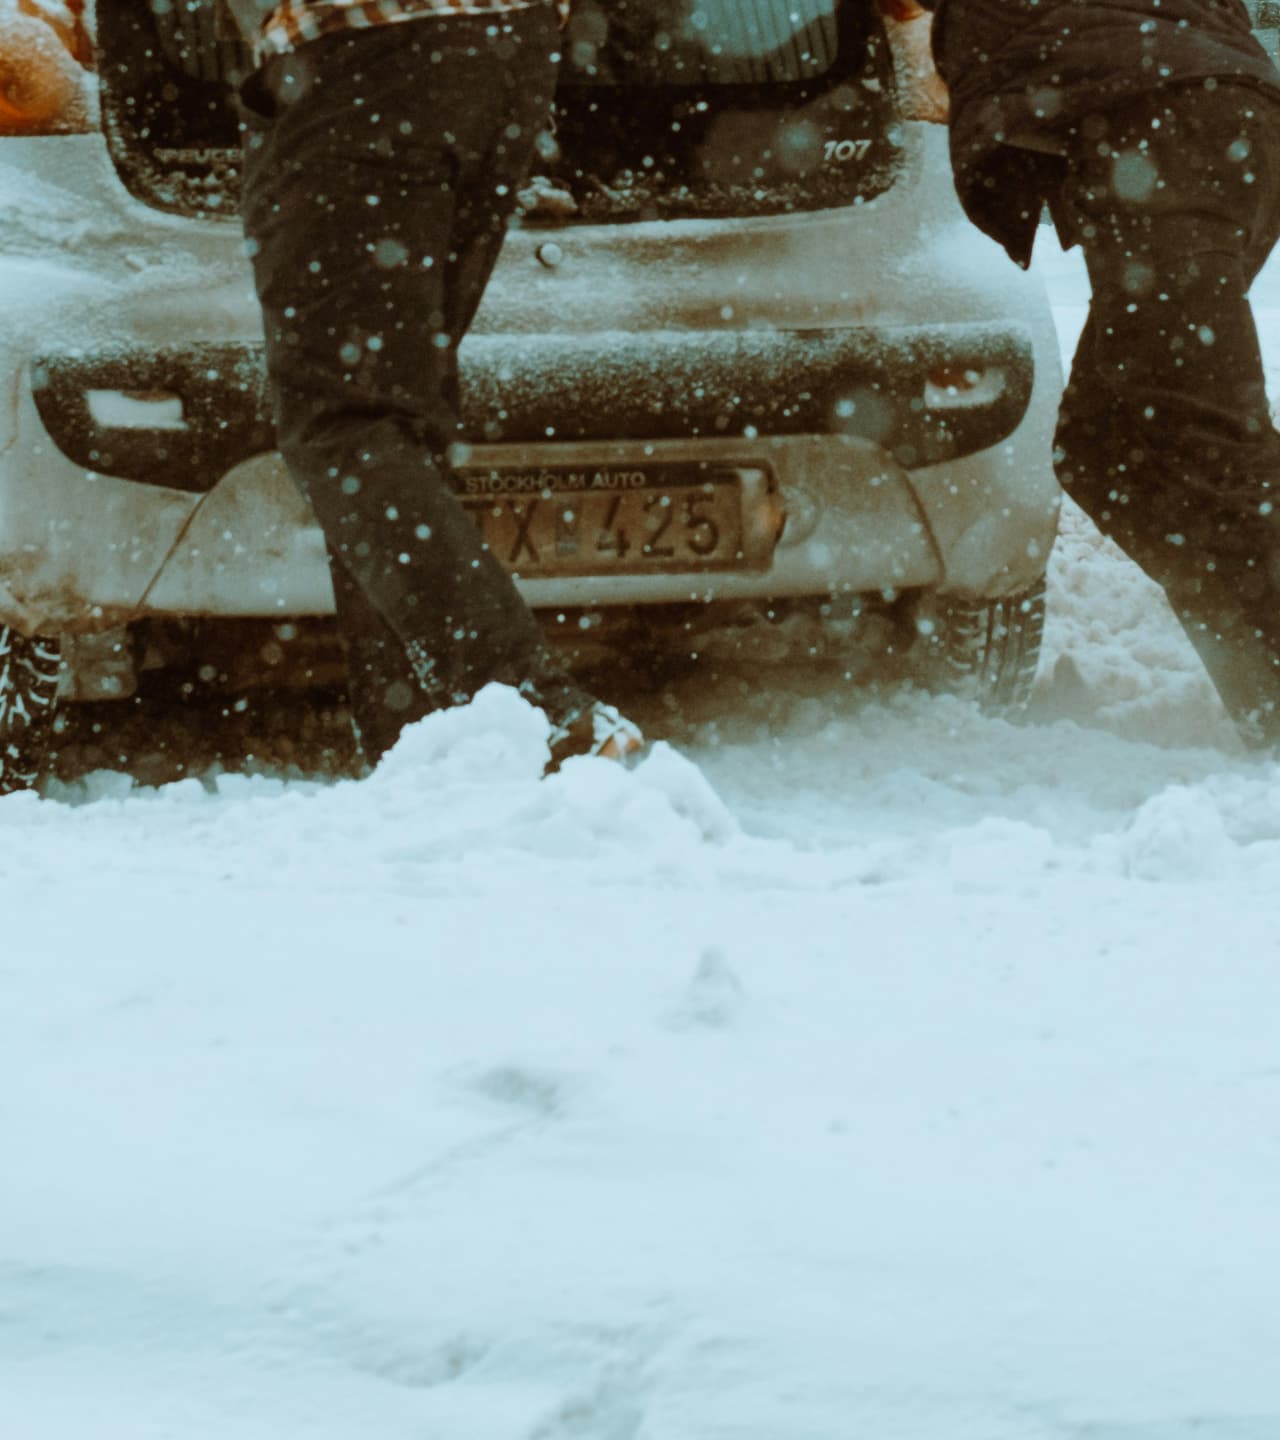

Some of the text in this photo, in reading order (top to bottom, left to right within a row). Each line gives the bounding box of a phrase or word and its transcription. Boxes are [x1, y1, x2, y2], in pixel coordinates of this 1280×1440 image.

[824, 139, 872, 161] 107
[465, 471, 646, 493] STOCKHOLM AUTO
[596, 493, 719, 560] 425
